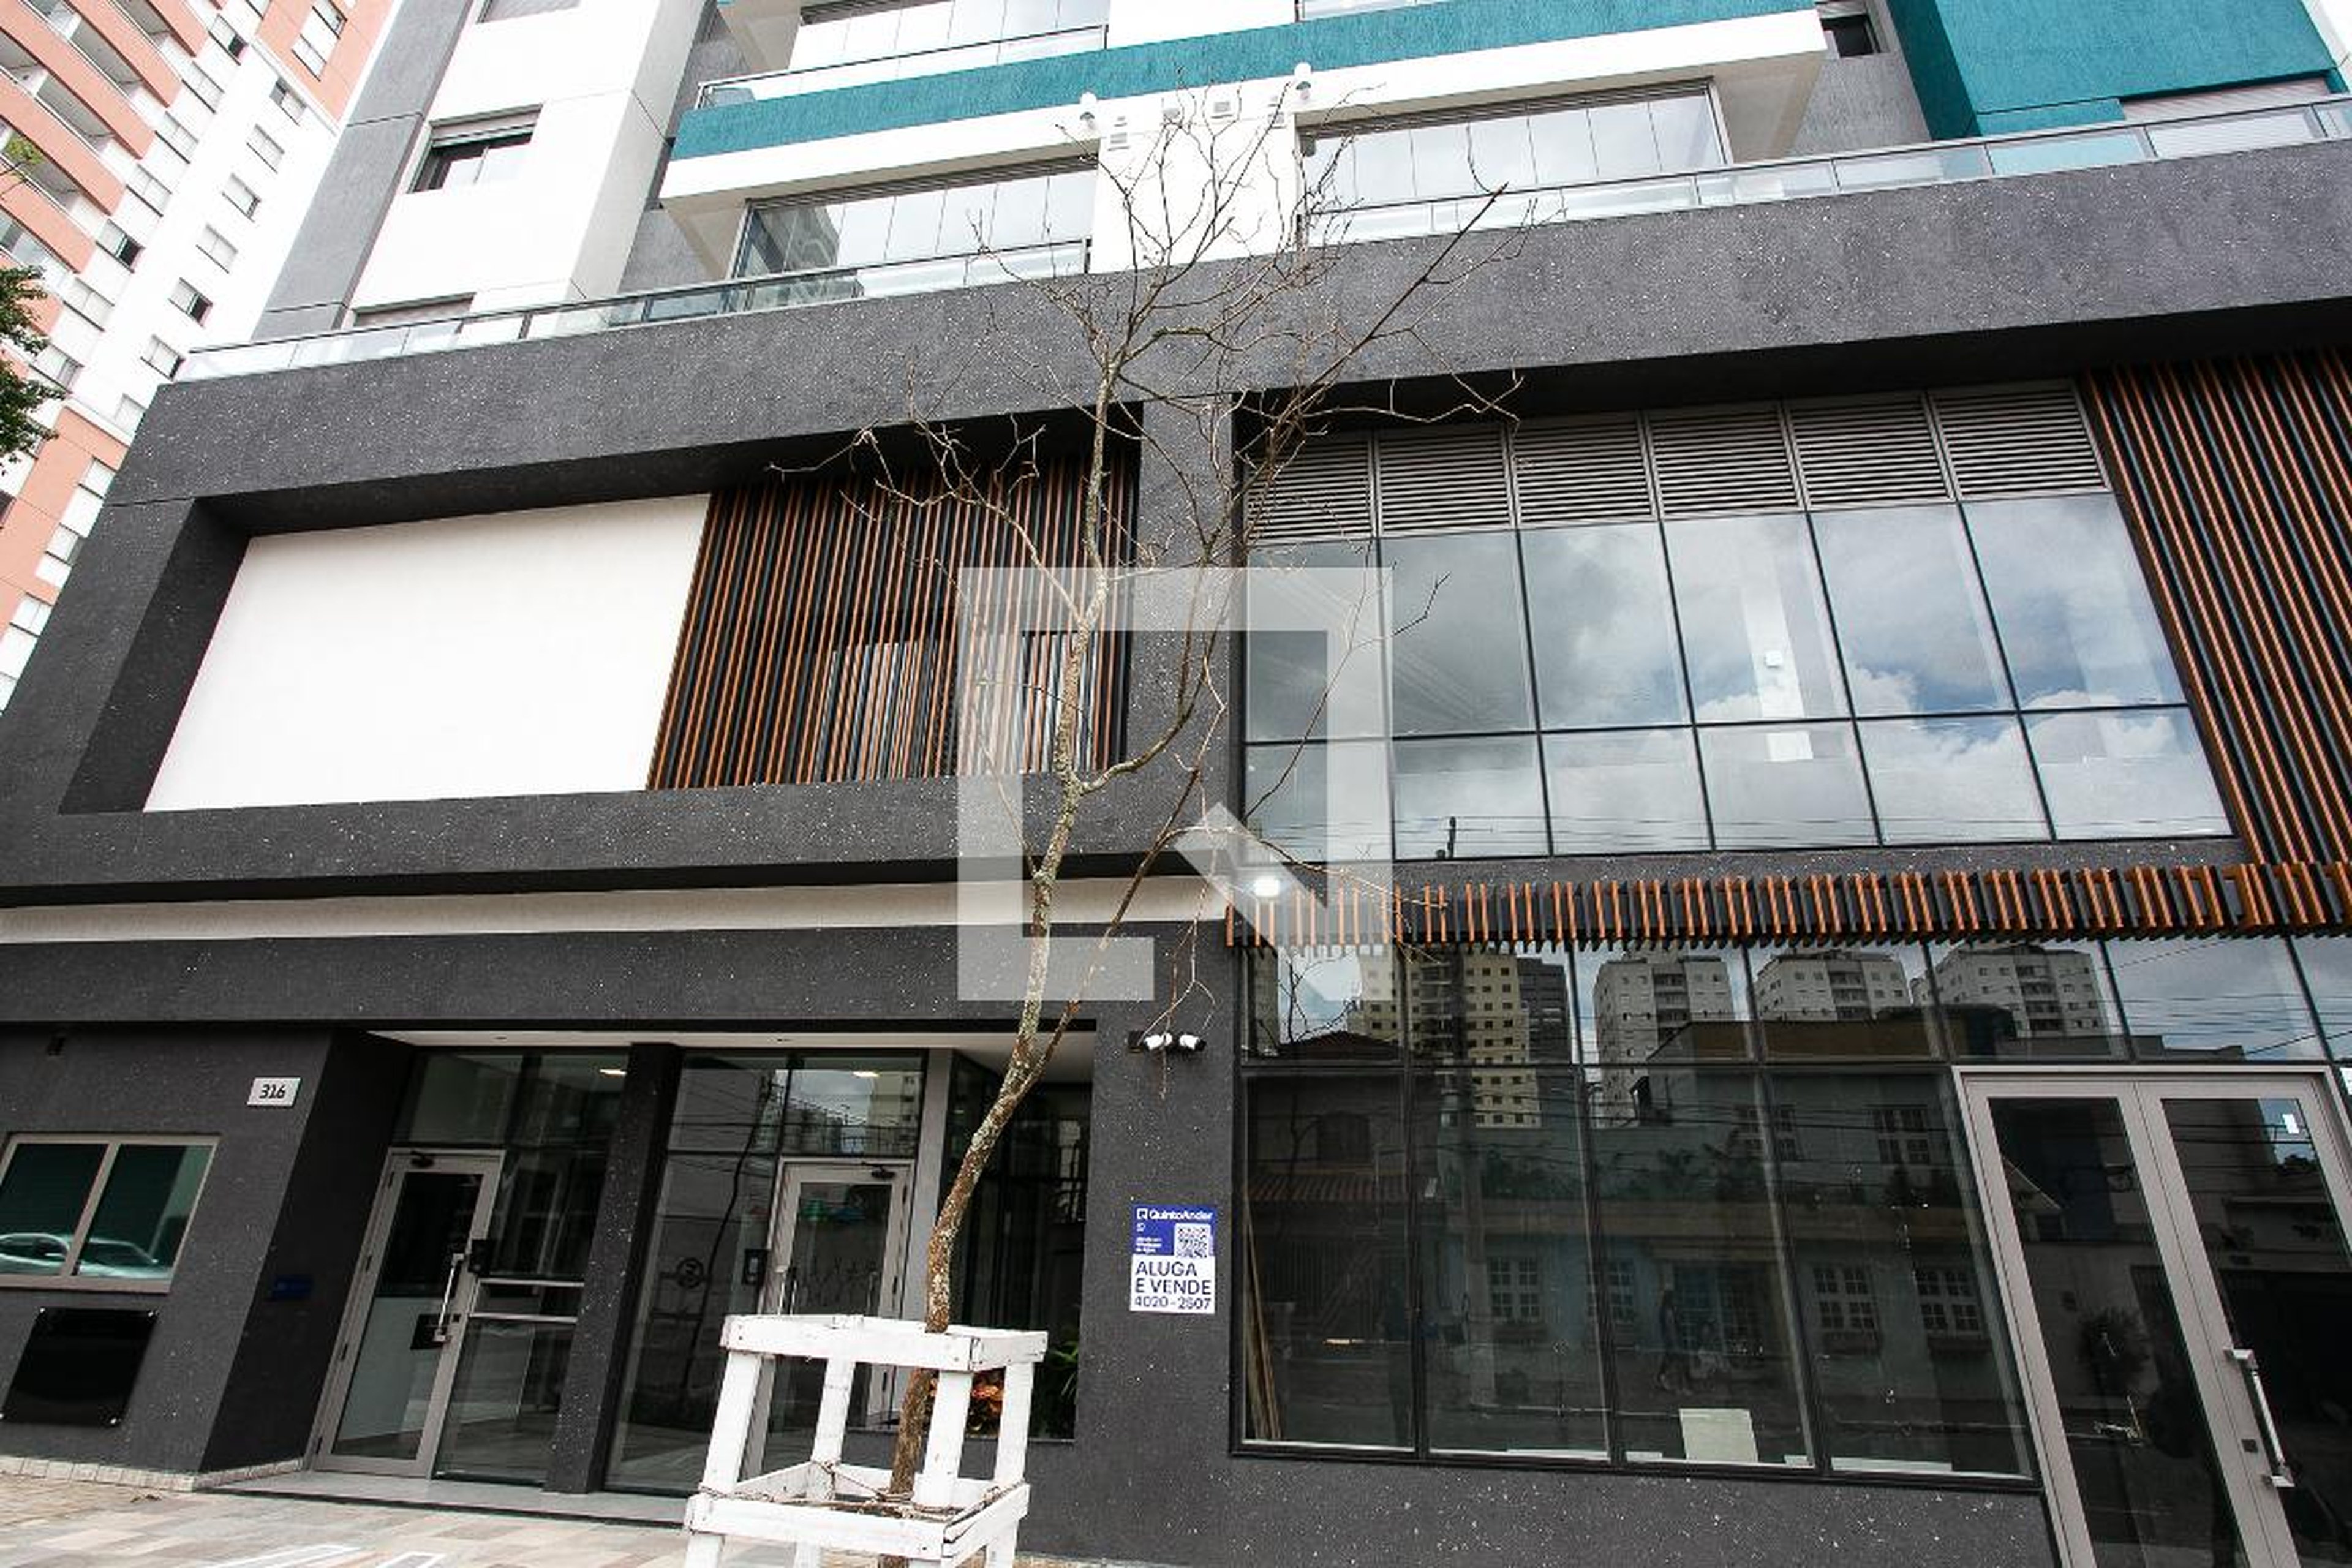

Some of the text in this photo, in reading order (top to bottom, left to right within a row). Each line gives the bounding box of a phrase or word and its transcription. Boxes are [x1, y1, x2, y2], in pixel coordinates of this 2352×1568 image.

[259, 1084, 286, 1099] 316
[1135, 1261, 1197, 1276] ALUGA
[1135, 1278, 1212, 1295] E VENDE
